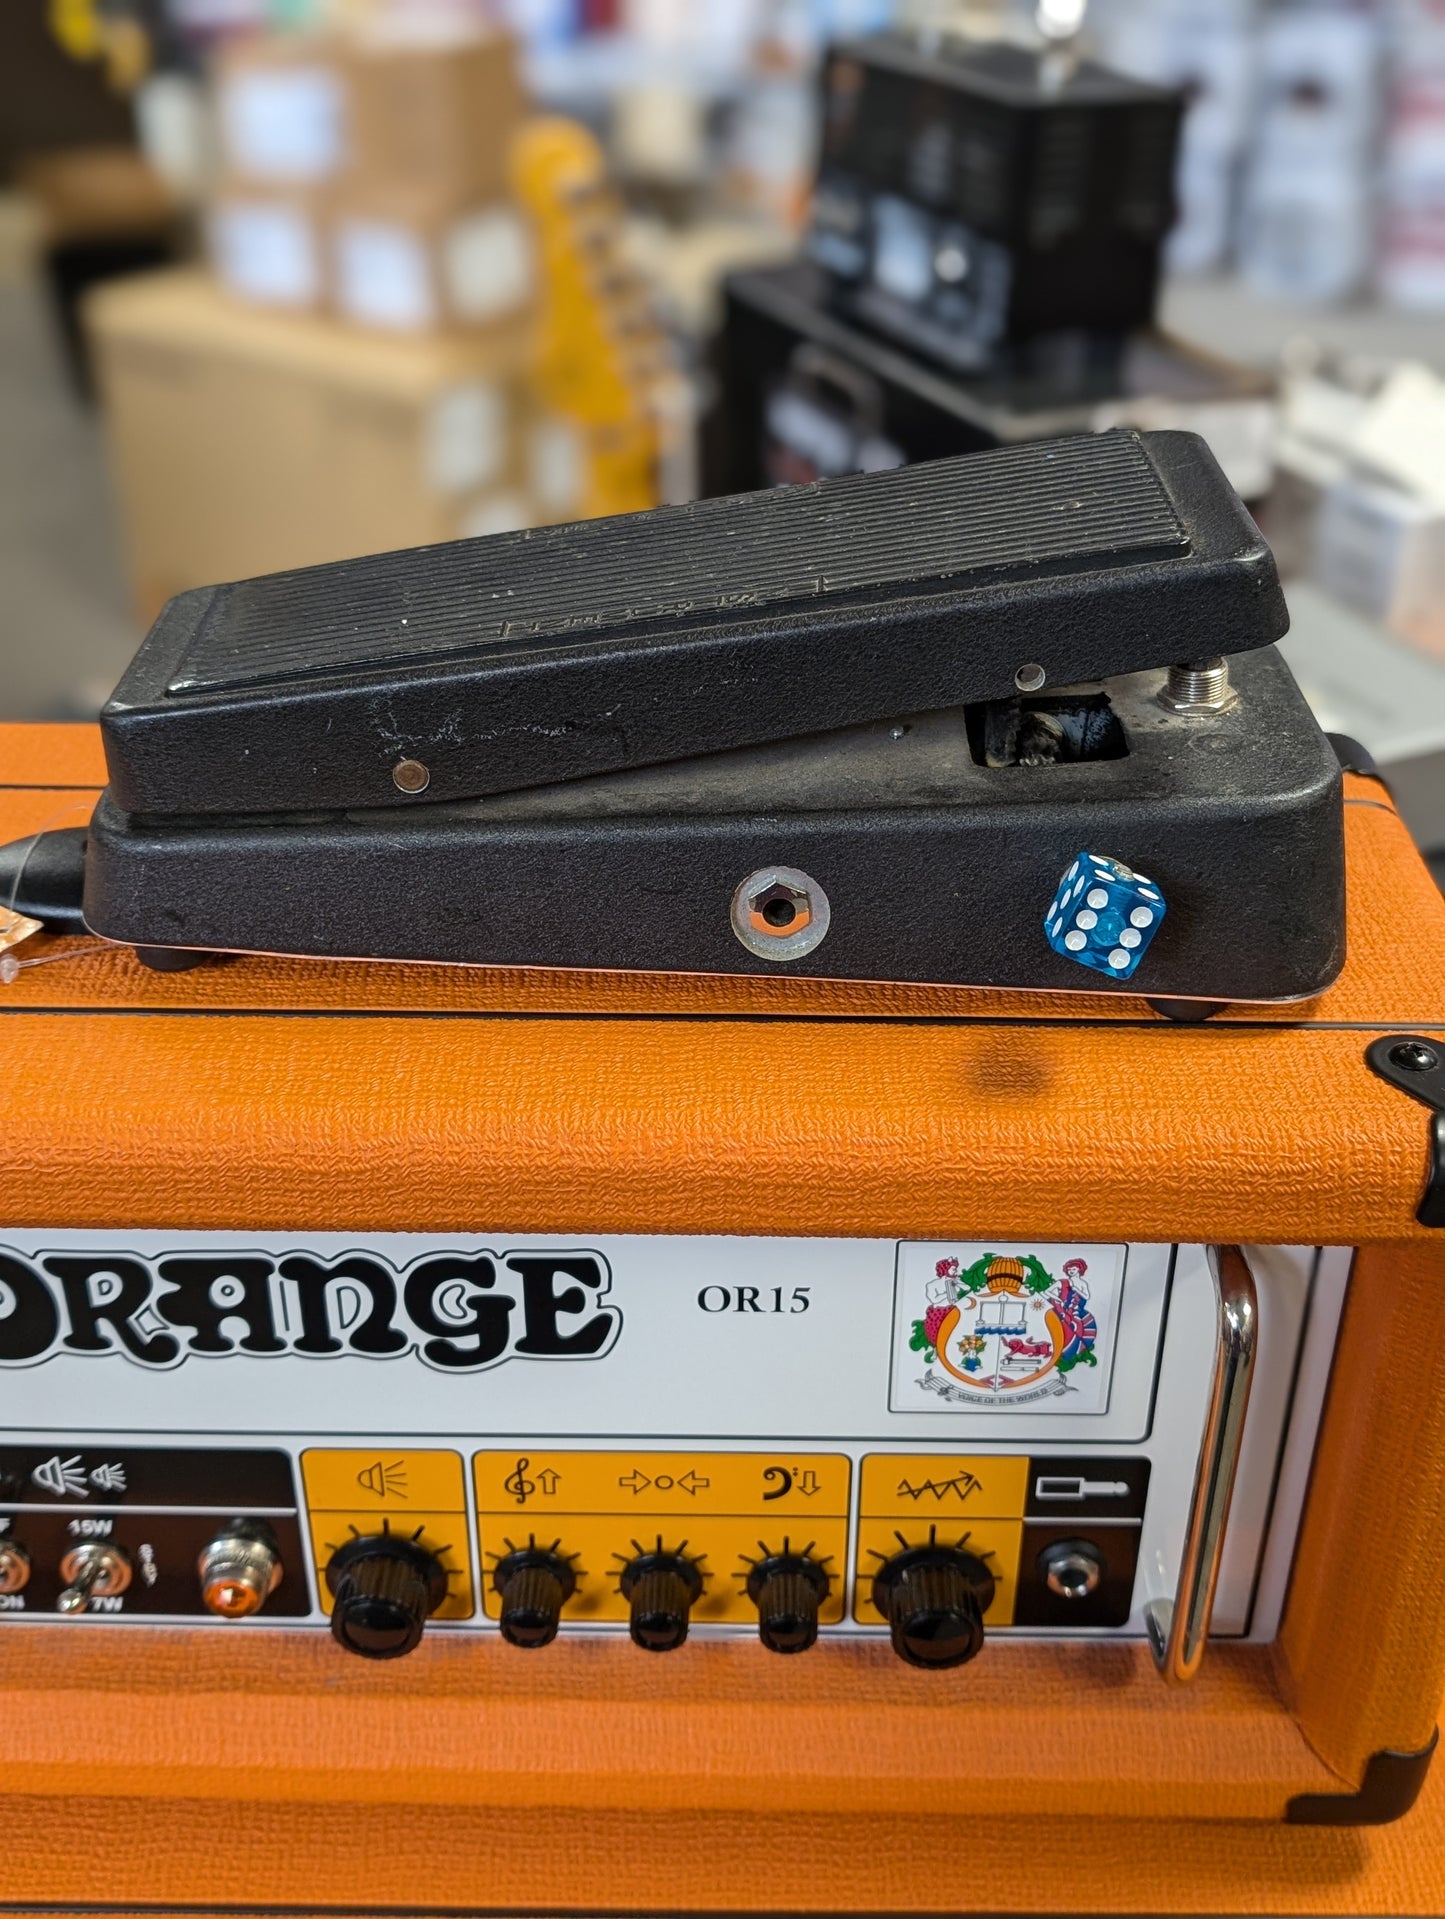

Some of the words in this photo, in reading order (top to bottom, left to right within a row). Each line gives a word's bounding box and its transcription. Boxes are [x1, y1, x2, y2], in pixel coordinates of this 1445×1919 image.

[697, 1285, 811, 1314] OR15
[983, 1396, 995, 1405] OF
[999, 1396, 1015, 1405] THE
[1015, 1388, 1048, 1402] WORLD
[68, 1518, 113, 1537] 15W
[91, 1596, 124, 1613] 7W
